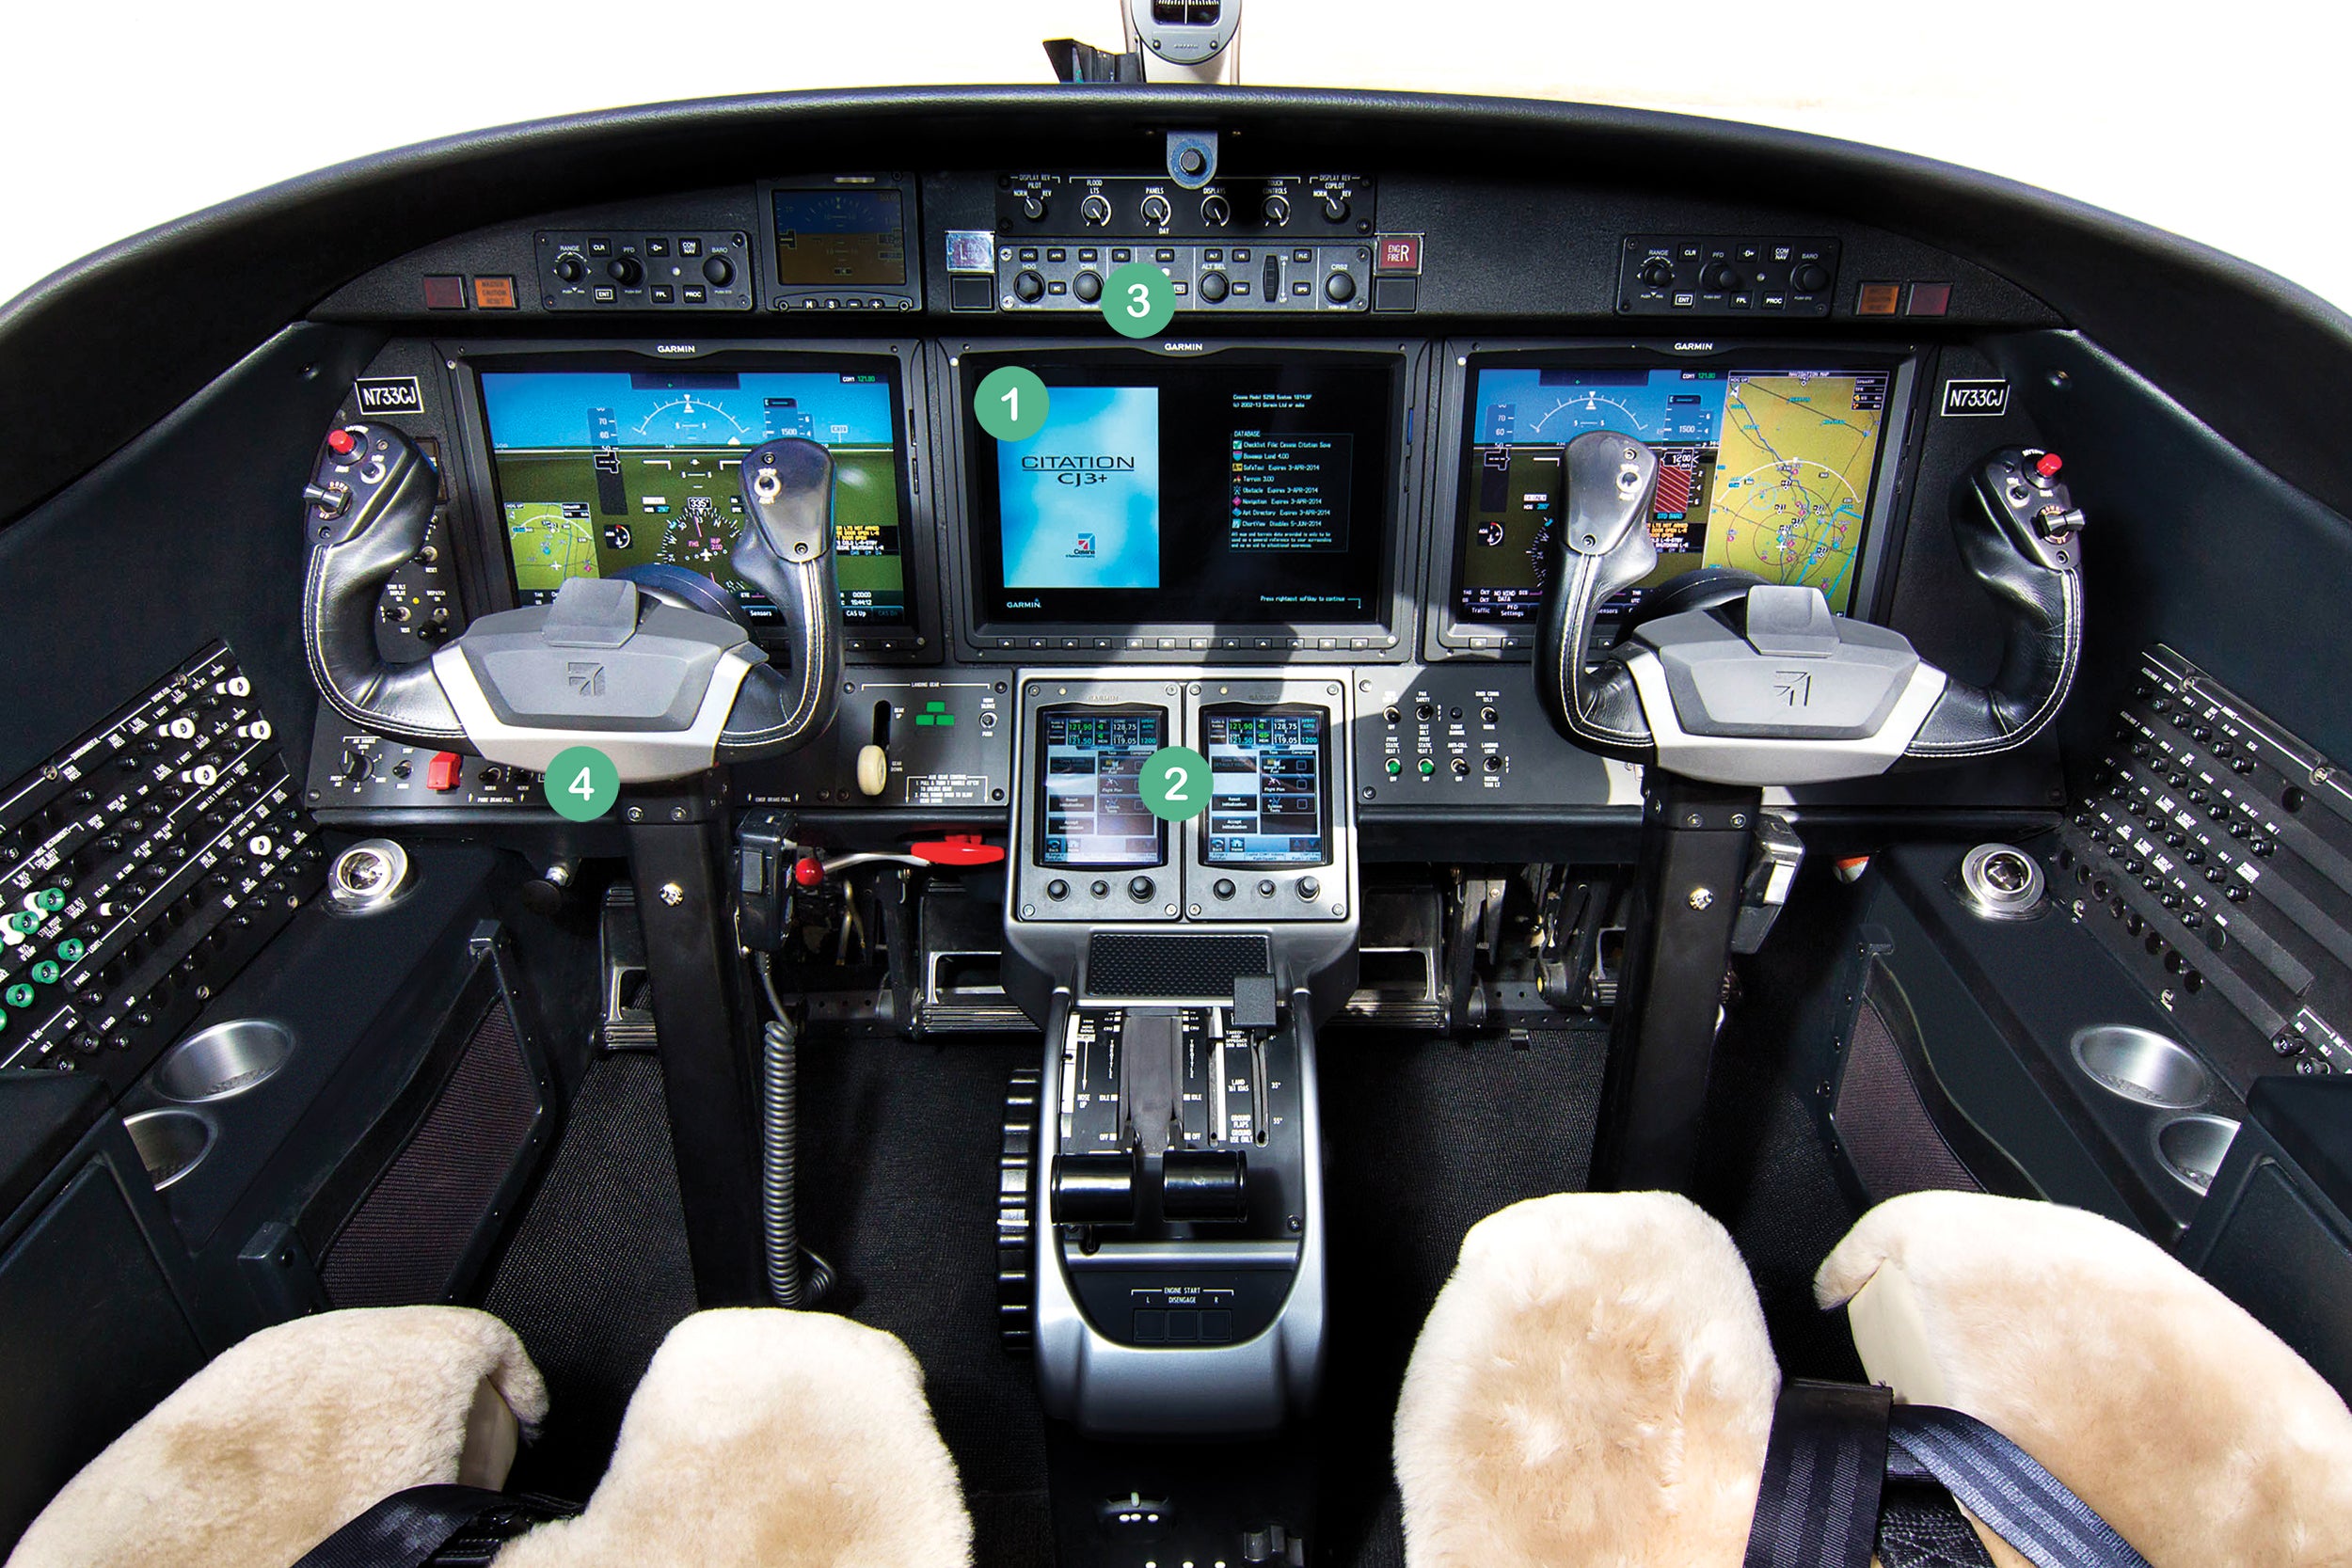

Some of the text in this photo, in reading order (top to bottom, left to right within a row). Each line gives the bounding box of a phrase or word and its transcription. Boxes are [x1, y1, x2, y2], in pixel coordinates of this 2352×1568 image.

[1387, 245, 1400, 253] ENG
[1400, 245, 1409, 262] R
[1387, 254, 1400, 262] FIRE
[657, 345, 695, 354] GARMIN
[1675, 342, 1713, 351] GARMIN
[363, 387, 417, 405] N733CJ
[1950, 389, 2004, 406] N733CJ
[1022, 456, 1135, 469] CITATION
[1057, 472, 1108, 487] CJ3+
